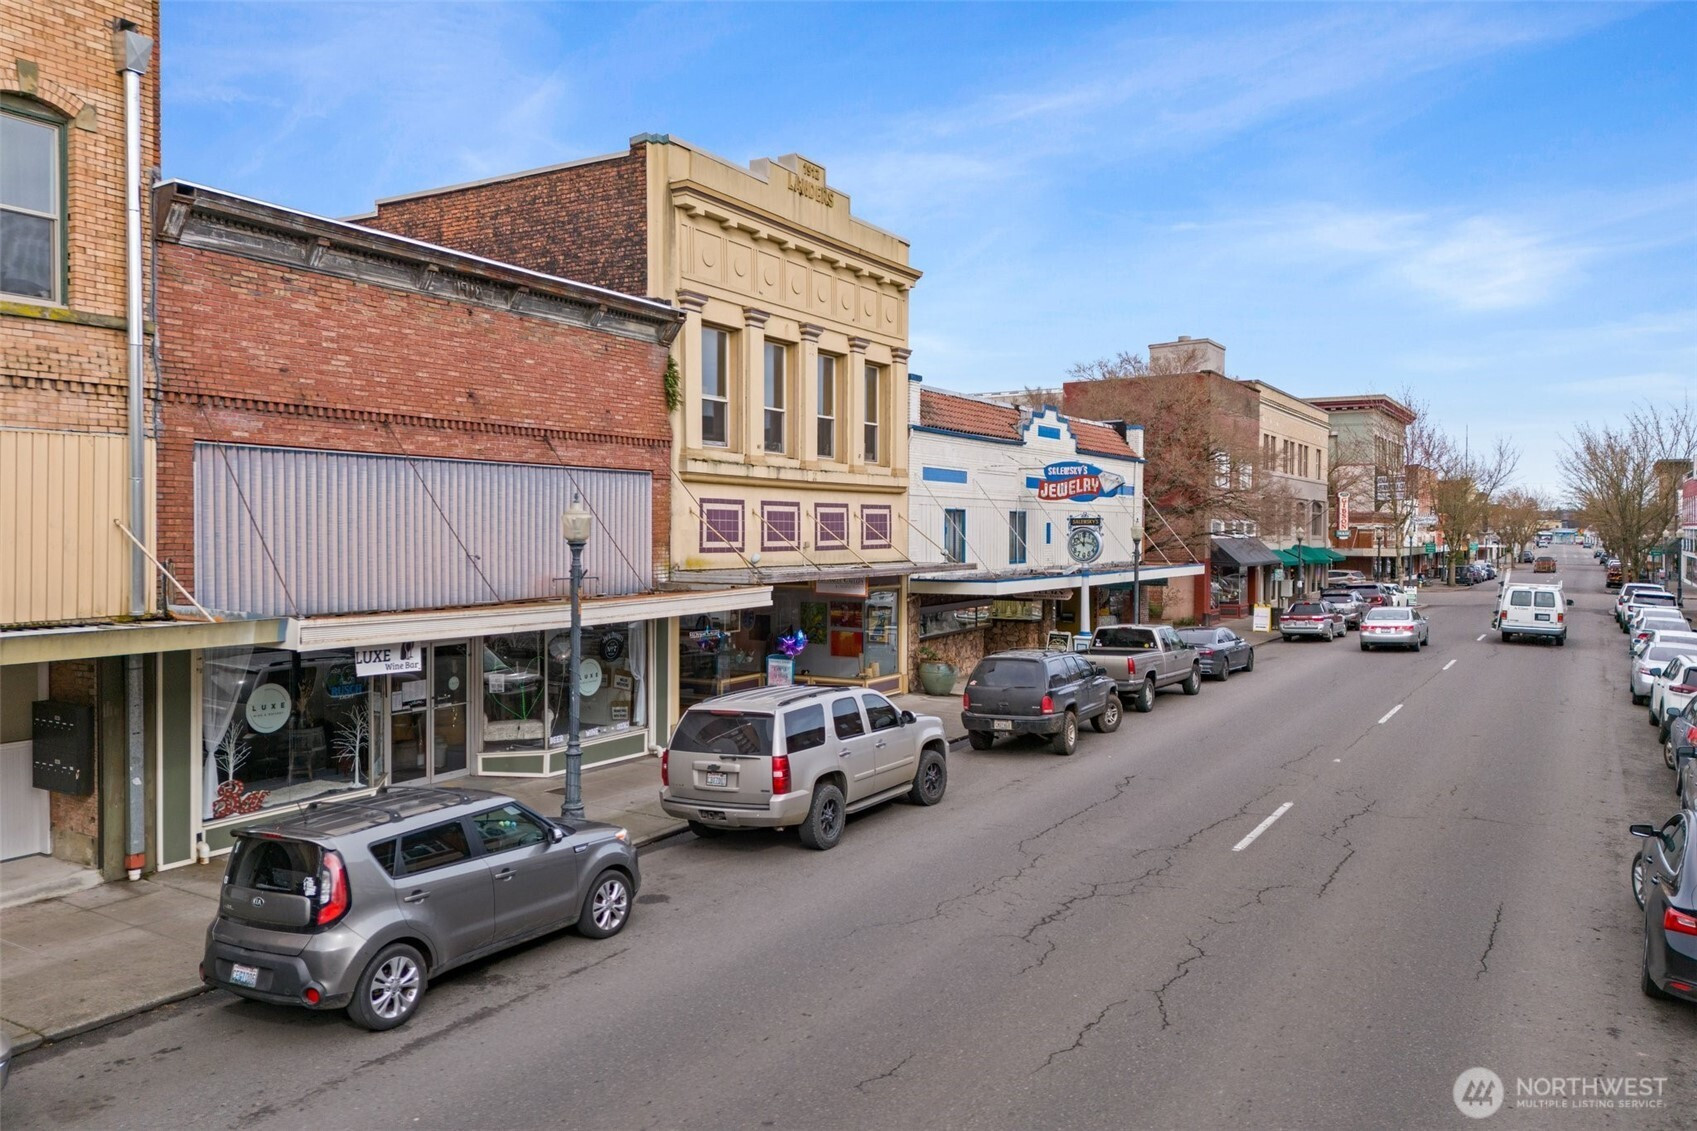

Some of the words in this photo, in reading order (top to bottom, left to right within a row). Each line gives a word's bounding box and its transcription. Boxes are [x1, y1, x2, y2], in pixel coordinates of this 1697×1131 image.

[787, 172, 834, 208] LANDERS
[1040, 478, 1099, 498] JEWELRY
[356, 649, 391, 664] LUXE
[385, 662, 403, 671] Wine
[252, 702, 285, 712] LUXE
[212, 779, 272, 819] Bar
